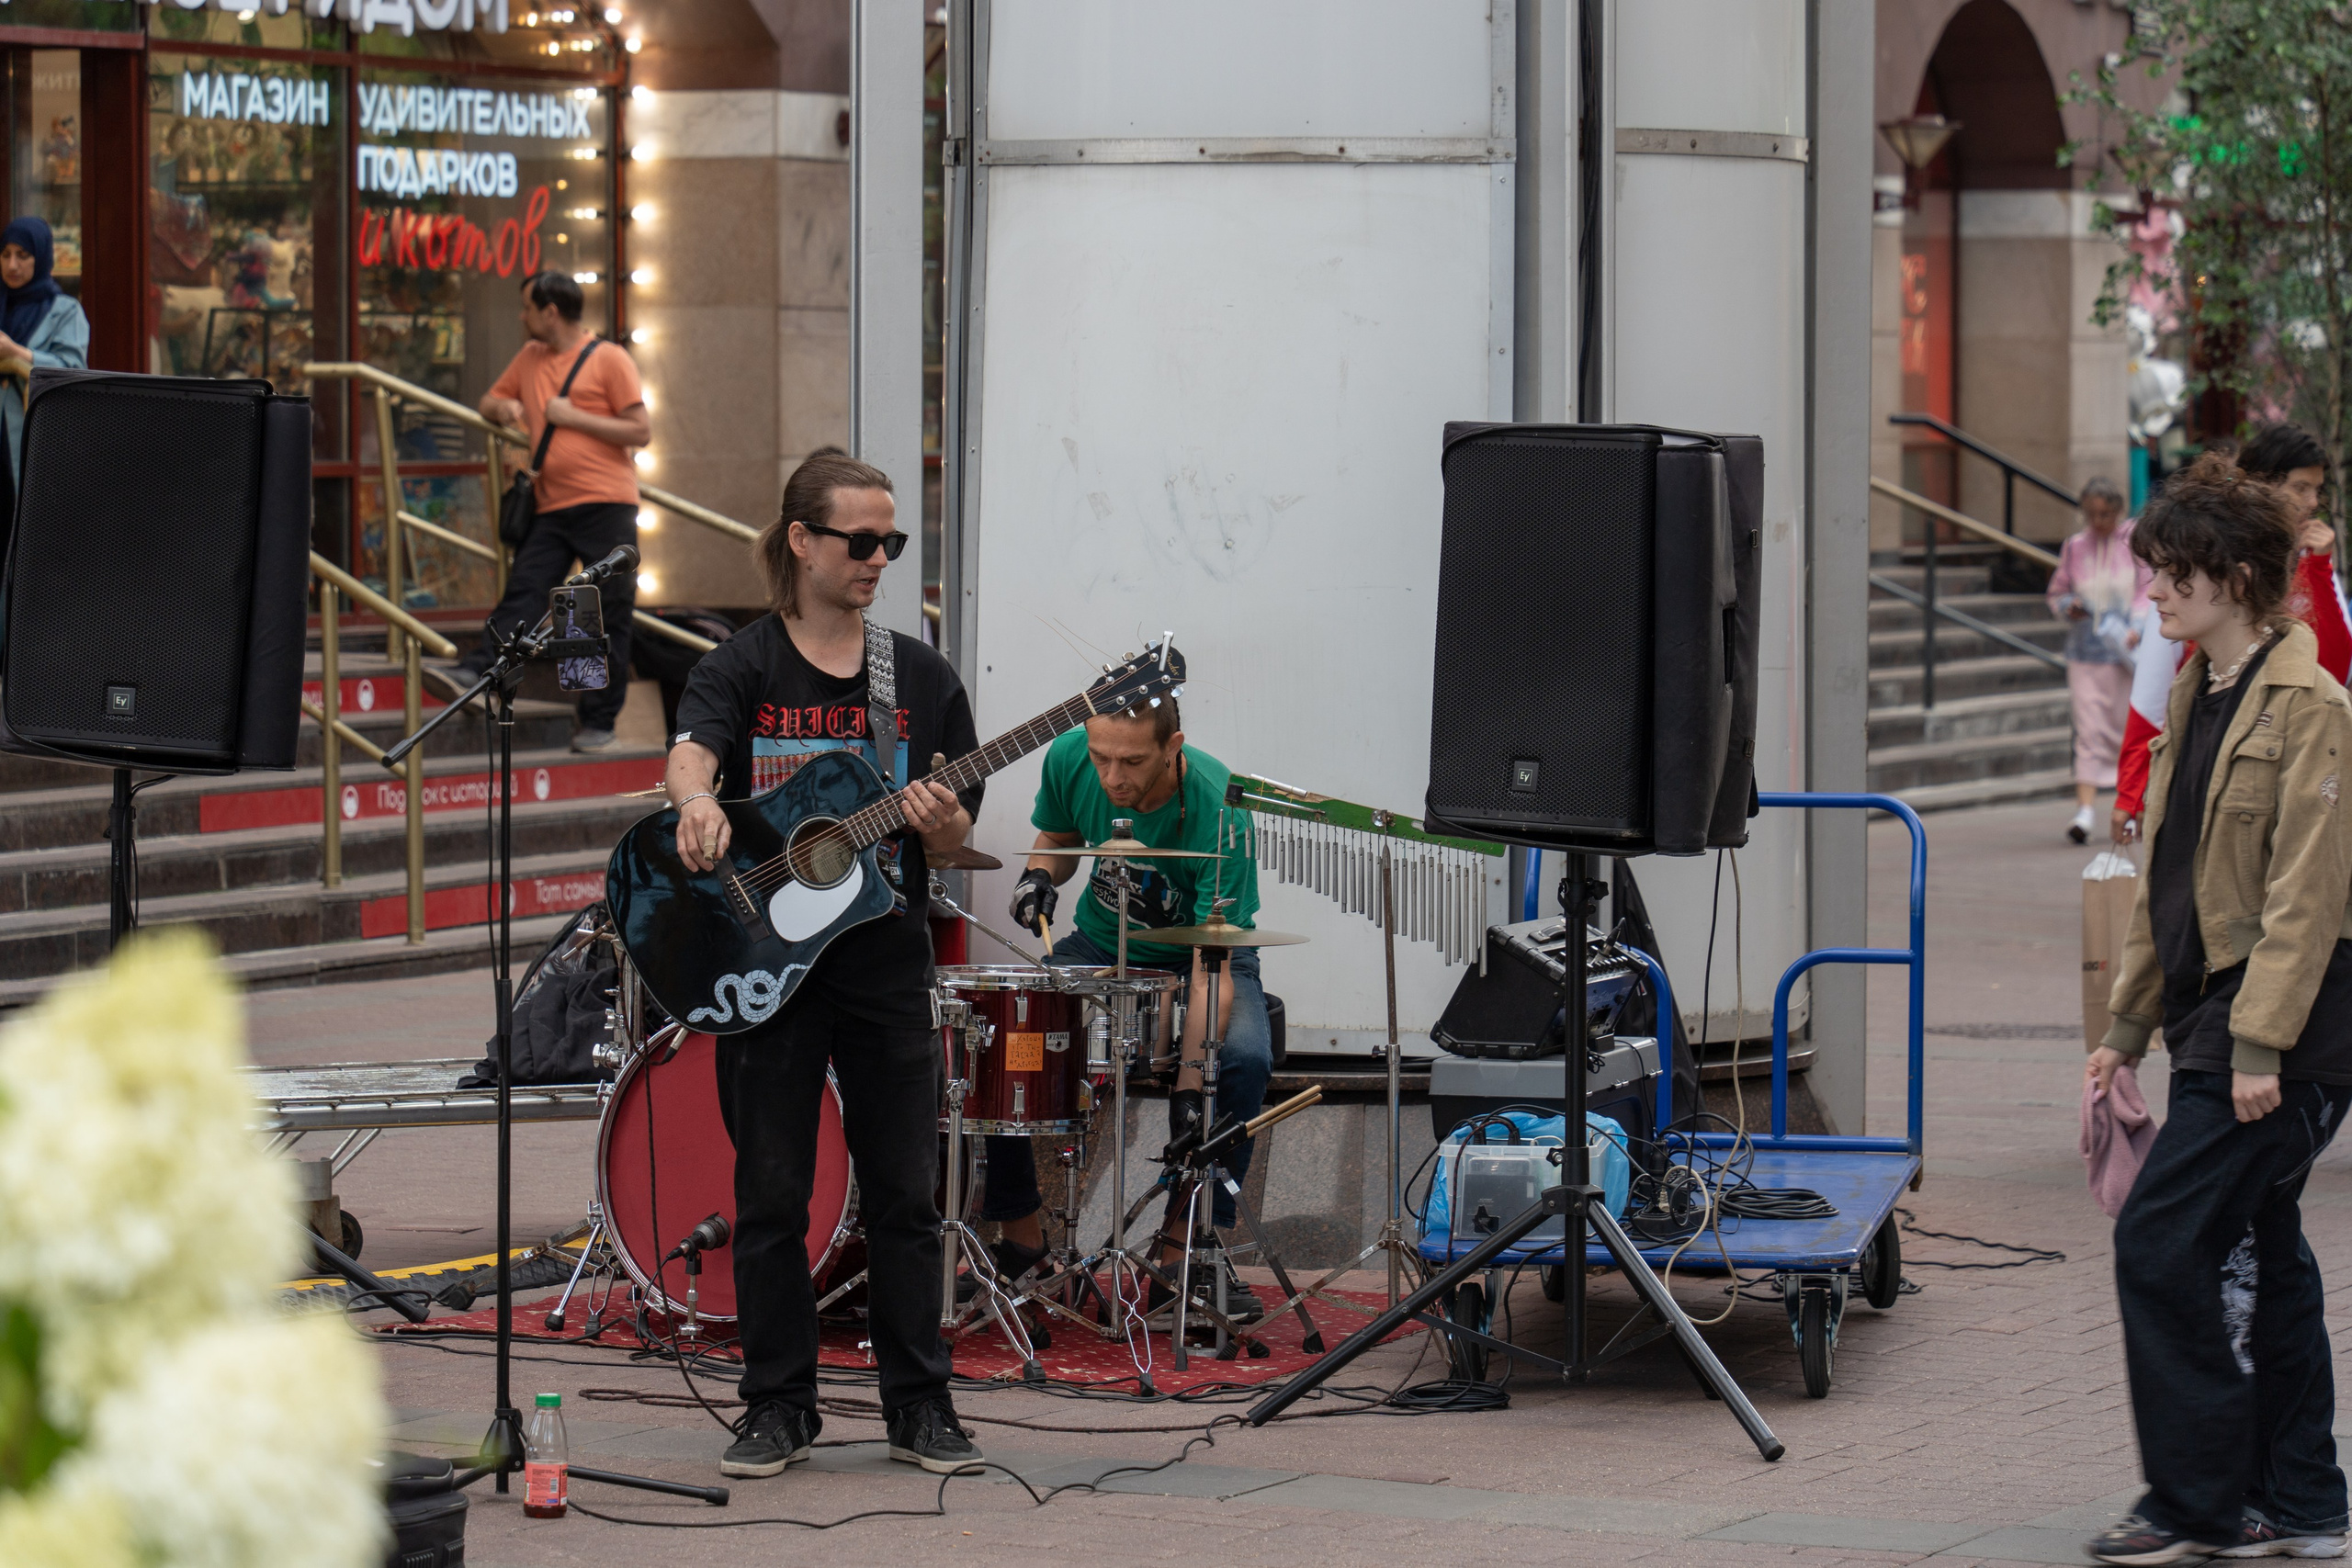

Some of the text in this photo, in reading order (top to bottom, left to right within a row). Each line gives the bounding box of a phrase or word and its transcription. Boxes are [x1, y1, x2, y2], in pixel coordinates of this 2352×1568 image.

[183, 70, 592, 139] МАГАЗИН УДИВИТЕЛЬНЫХ
[357, 144, 518, 200] ПОДАРКОВ
[358, 185, 549, 277] и котов
[749, 703, 911, 745] SUICIE
[534, 879, 562, 904] Тот
